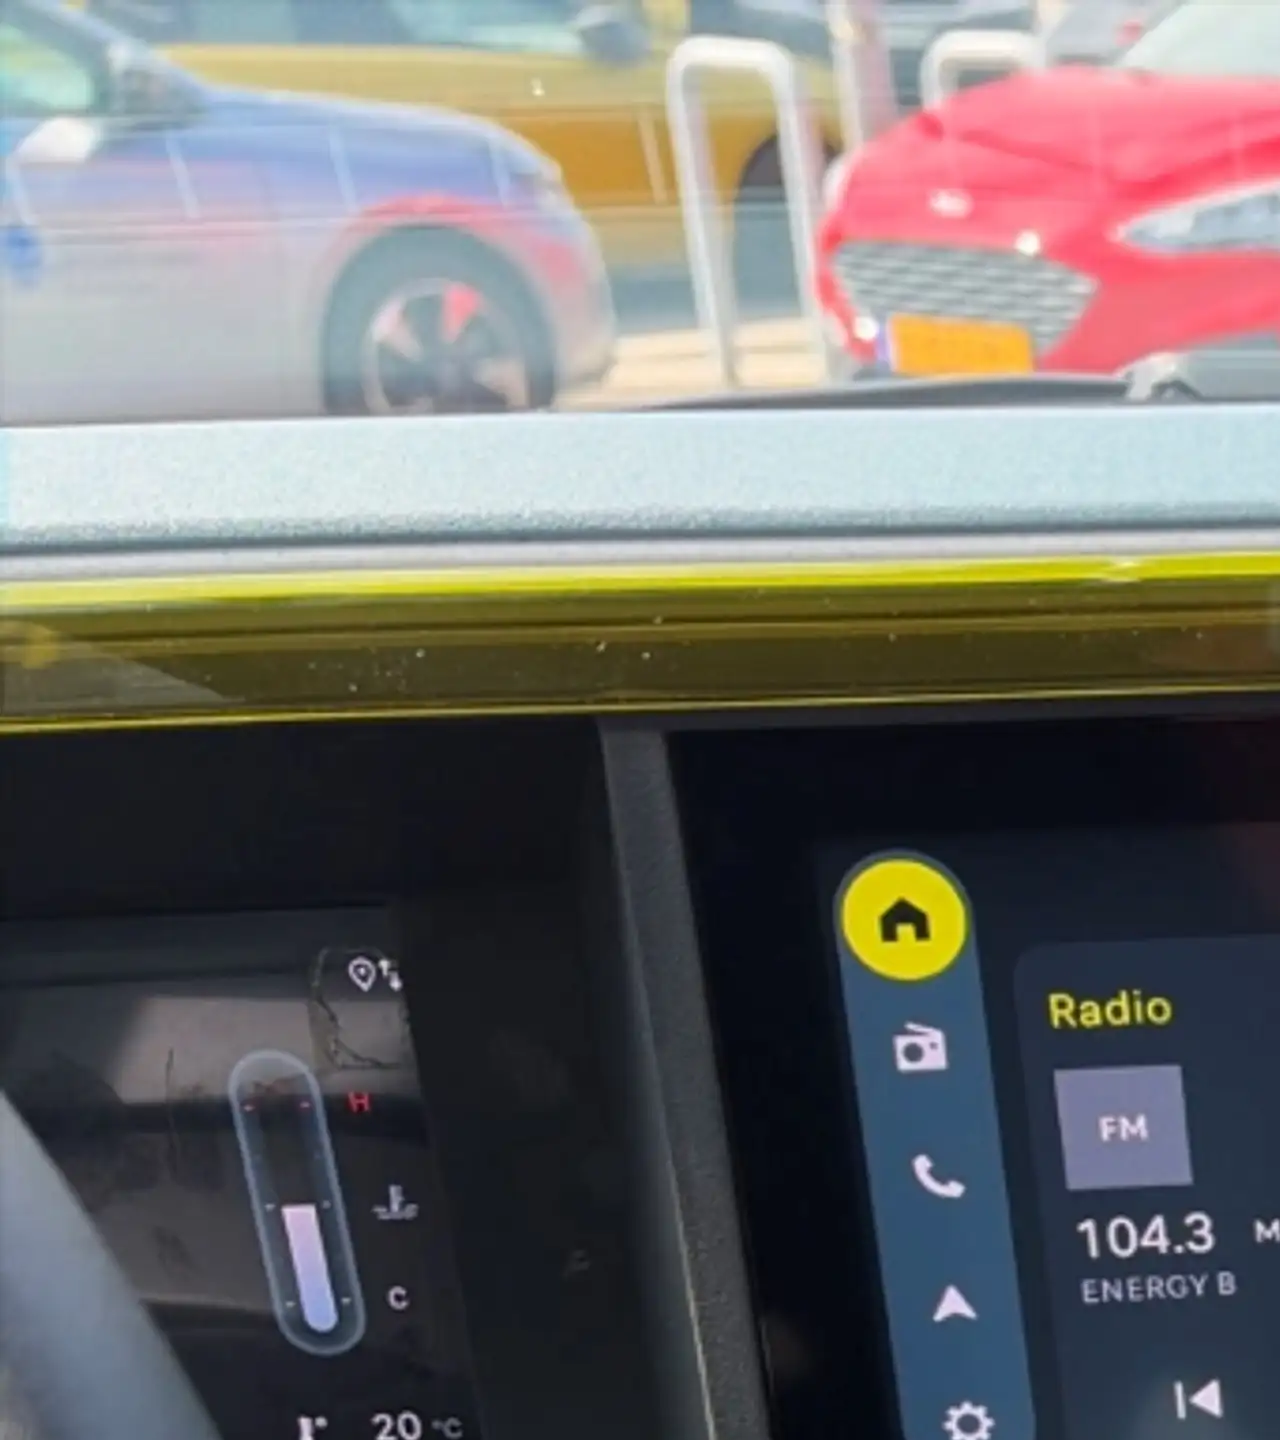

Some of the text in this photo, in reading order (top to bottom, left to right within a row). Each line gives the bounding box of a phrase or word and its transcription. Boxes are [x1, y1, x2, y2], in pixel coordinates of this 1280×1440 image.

[1048, 991, 1172, 1029] Radio
[1100, 1114, 1148, 1141] FM
[1077, 1211, 1216, 1260] 104.3
[388, 1286, 409, 1311] C
[1082, 1271, 1237, 1304] ENERGY B
